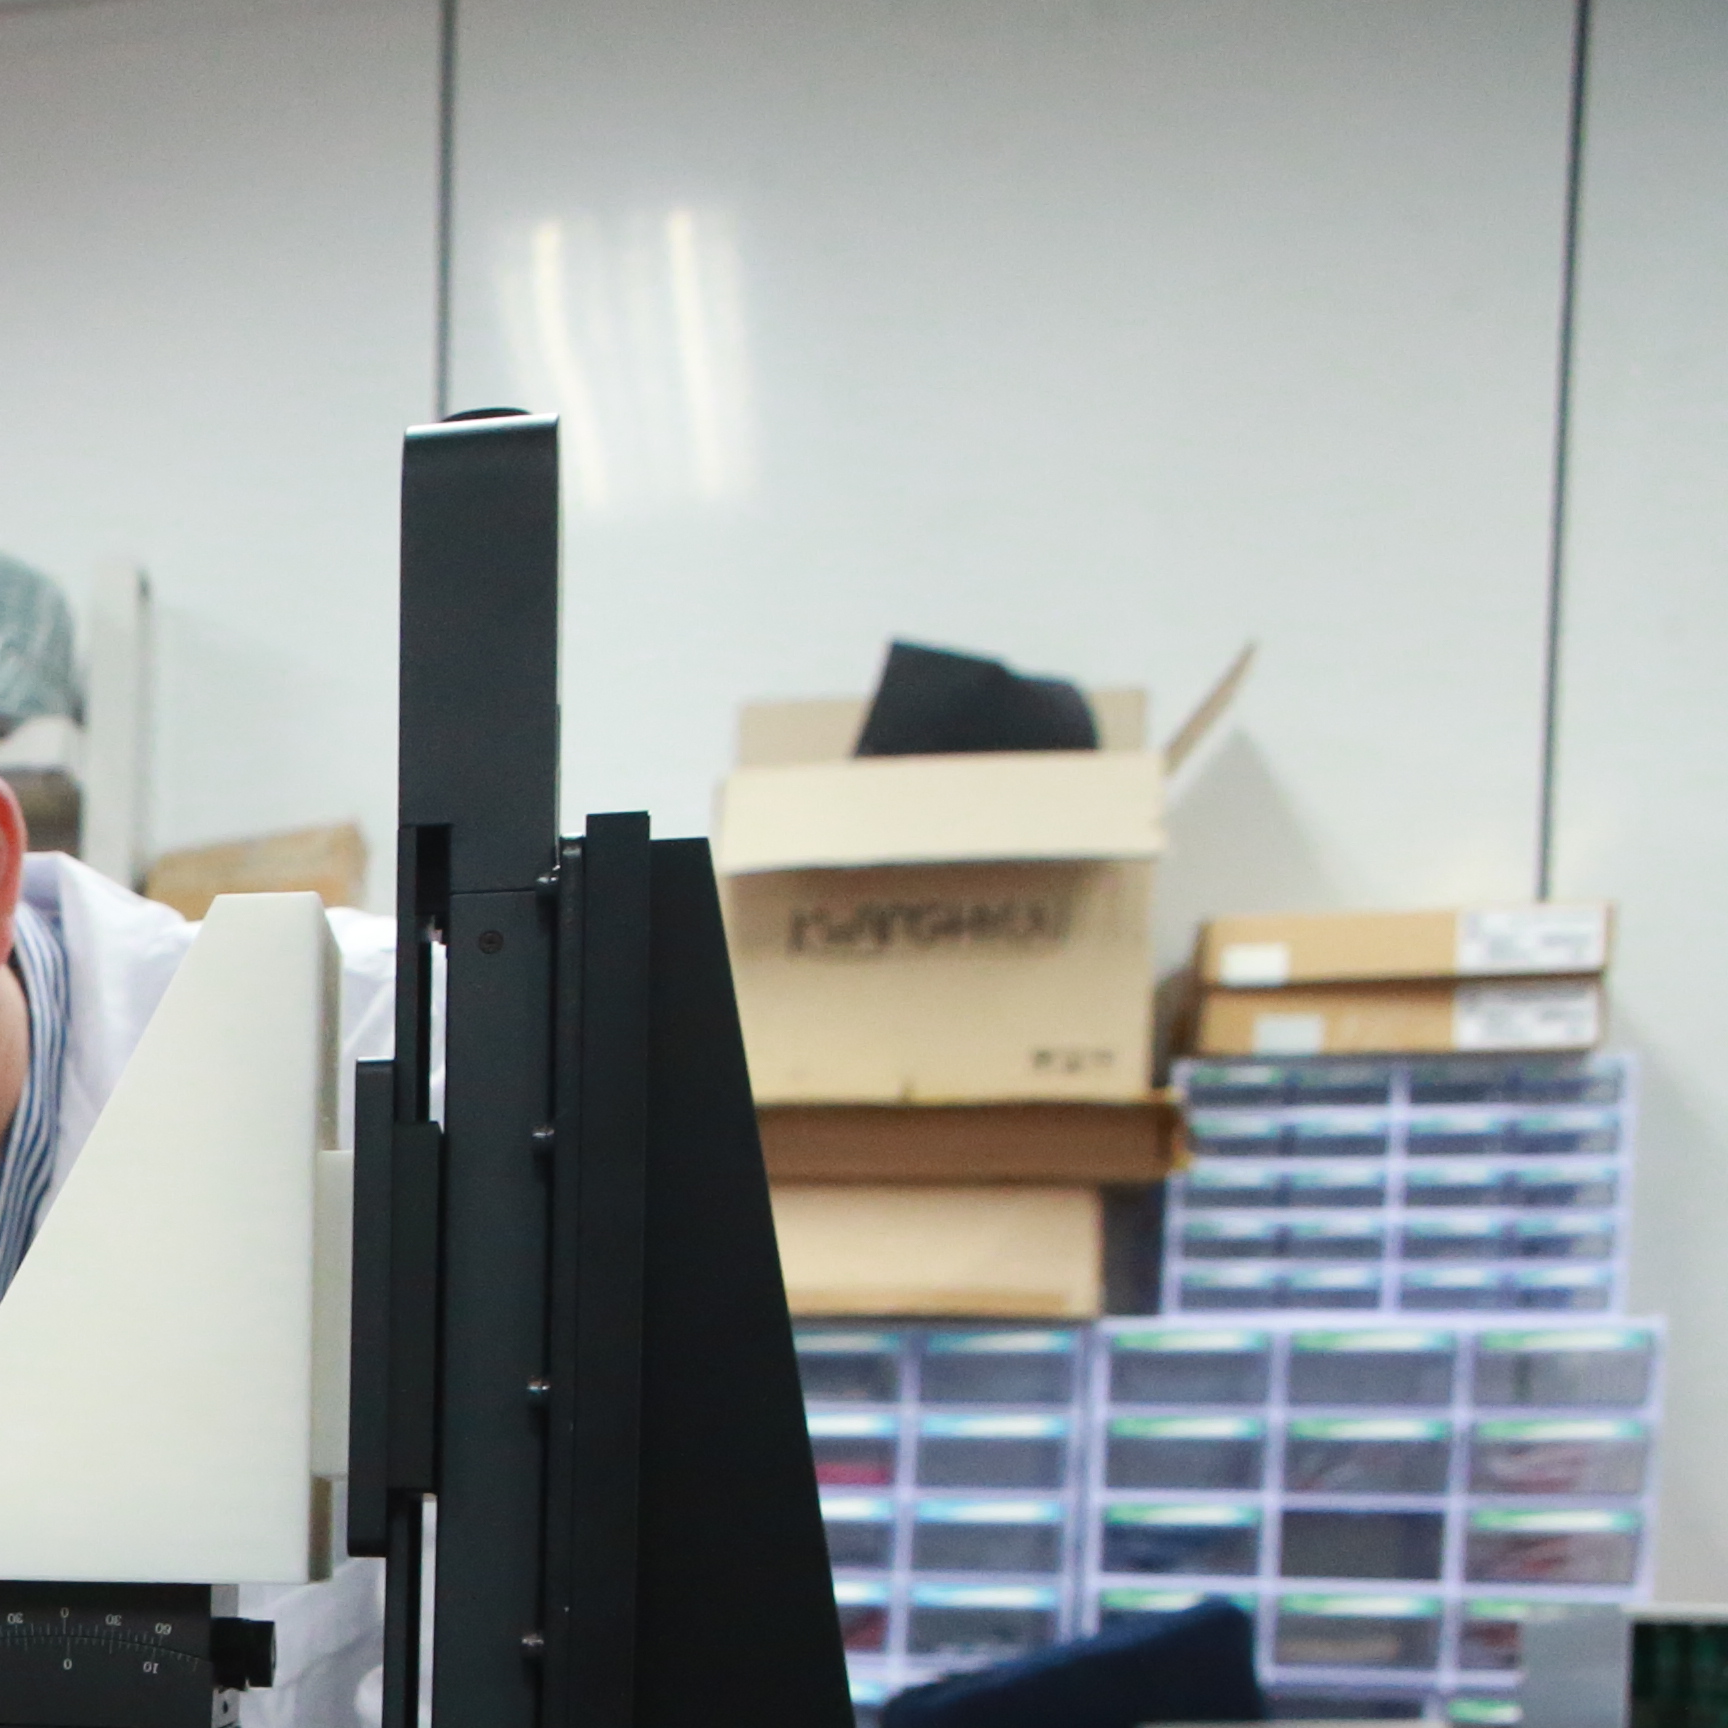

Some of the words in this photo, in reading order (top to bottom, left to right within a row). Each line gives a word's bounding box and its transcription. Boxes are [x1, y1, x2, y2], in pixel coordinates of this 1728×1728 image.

[7, 1612, 24, 1625] 30
[60, 1607, 70, 1619] 0
[105, 1614, 122, 1627] 30
[155, 1622, 173, 1636] 60
[63, 1658, 73, 1671] 0
[143, 1661, 159, 1675] 10
